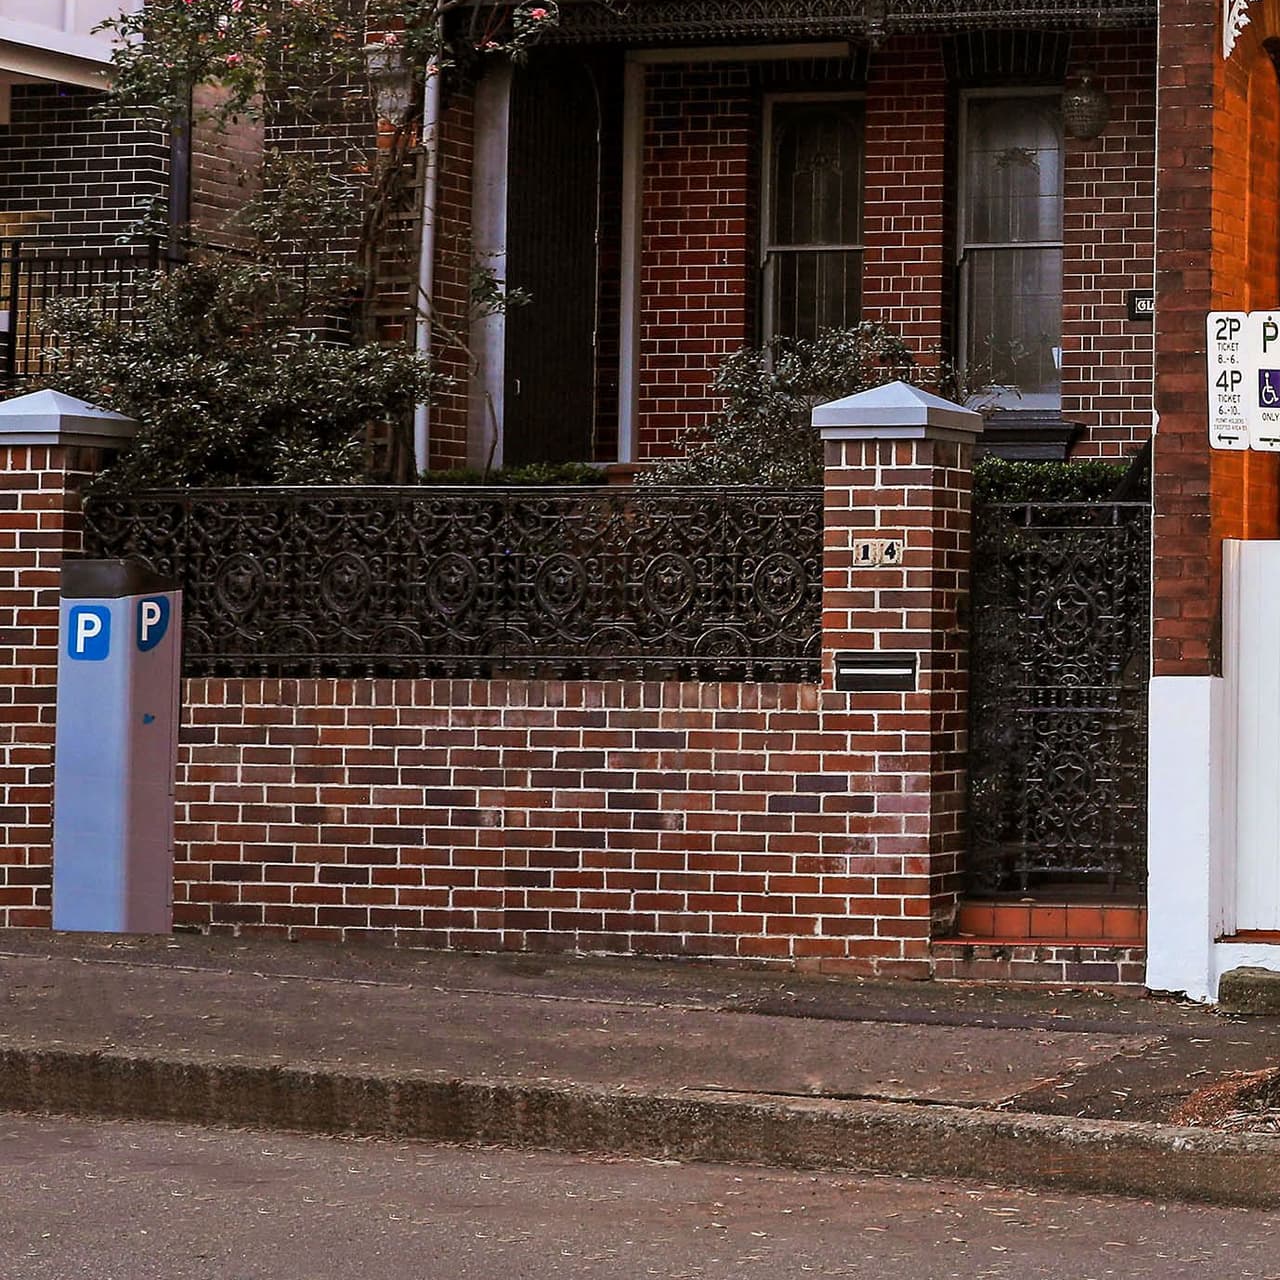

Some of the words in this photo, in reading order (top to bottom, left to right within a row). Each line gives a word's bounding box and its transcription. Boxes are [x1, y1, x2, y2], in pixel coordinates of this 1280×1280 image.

[1215, 318, 1241, 341] 2P
[1263, 322, 1279, 353] P
[1217, 342, 1239, 351] TICKET
[1215, 370, 1242, 392] 4P
[1218, 394, 1241, 403] TICKET
[1262, 412, 1280, 421] ONLY
[860, 541, 897, 561] 14
[141, 601, 161, 642] P
[77, 613, 102, 653] P
